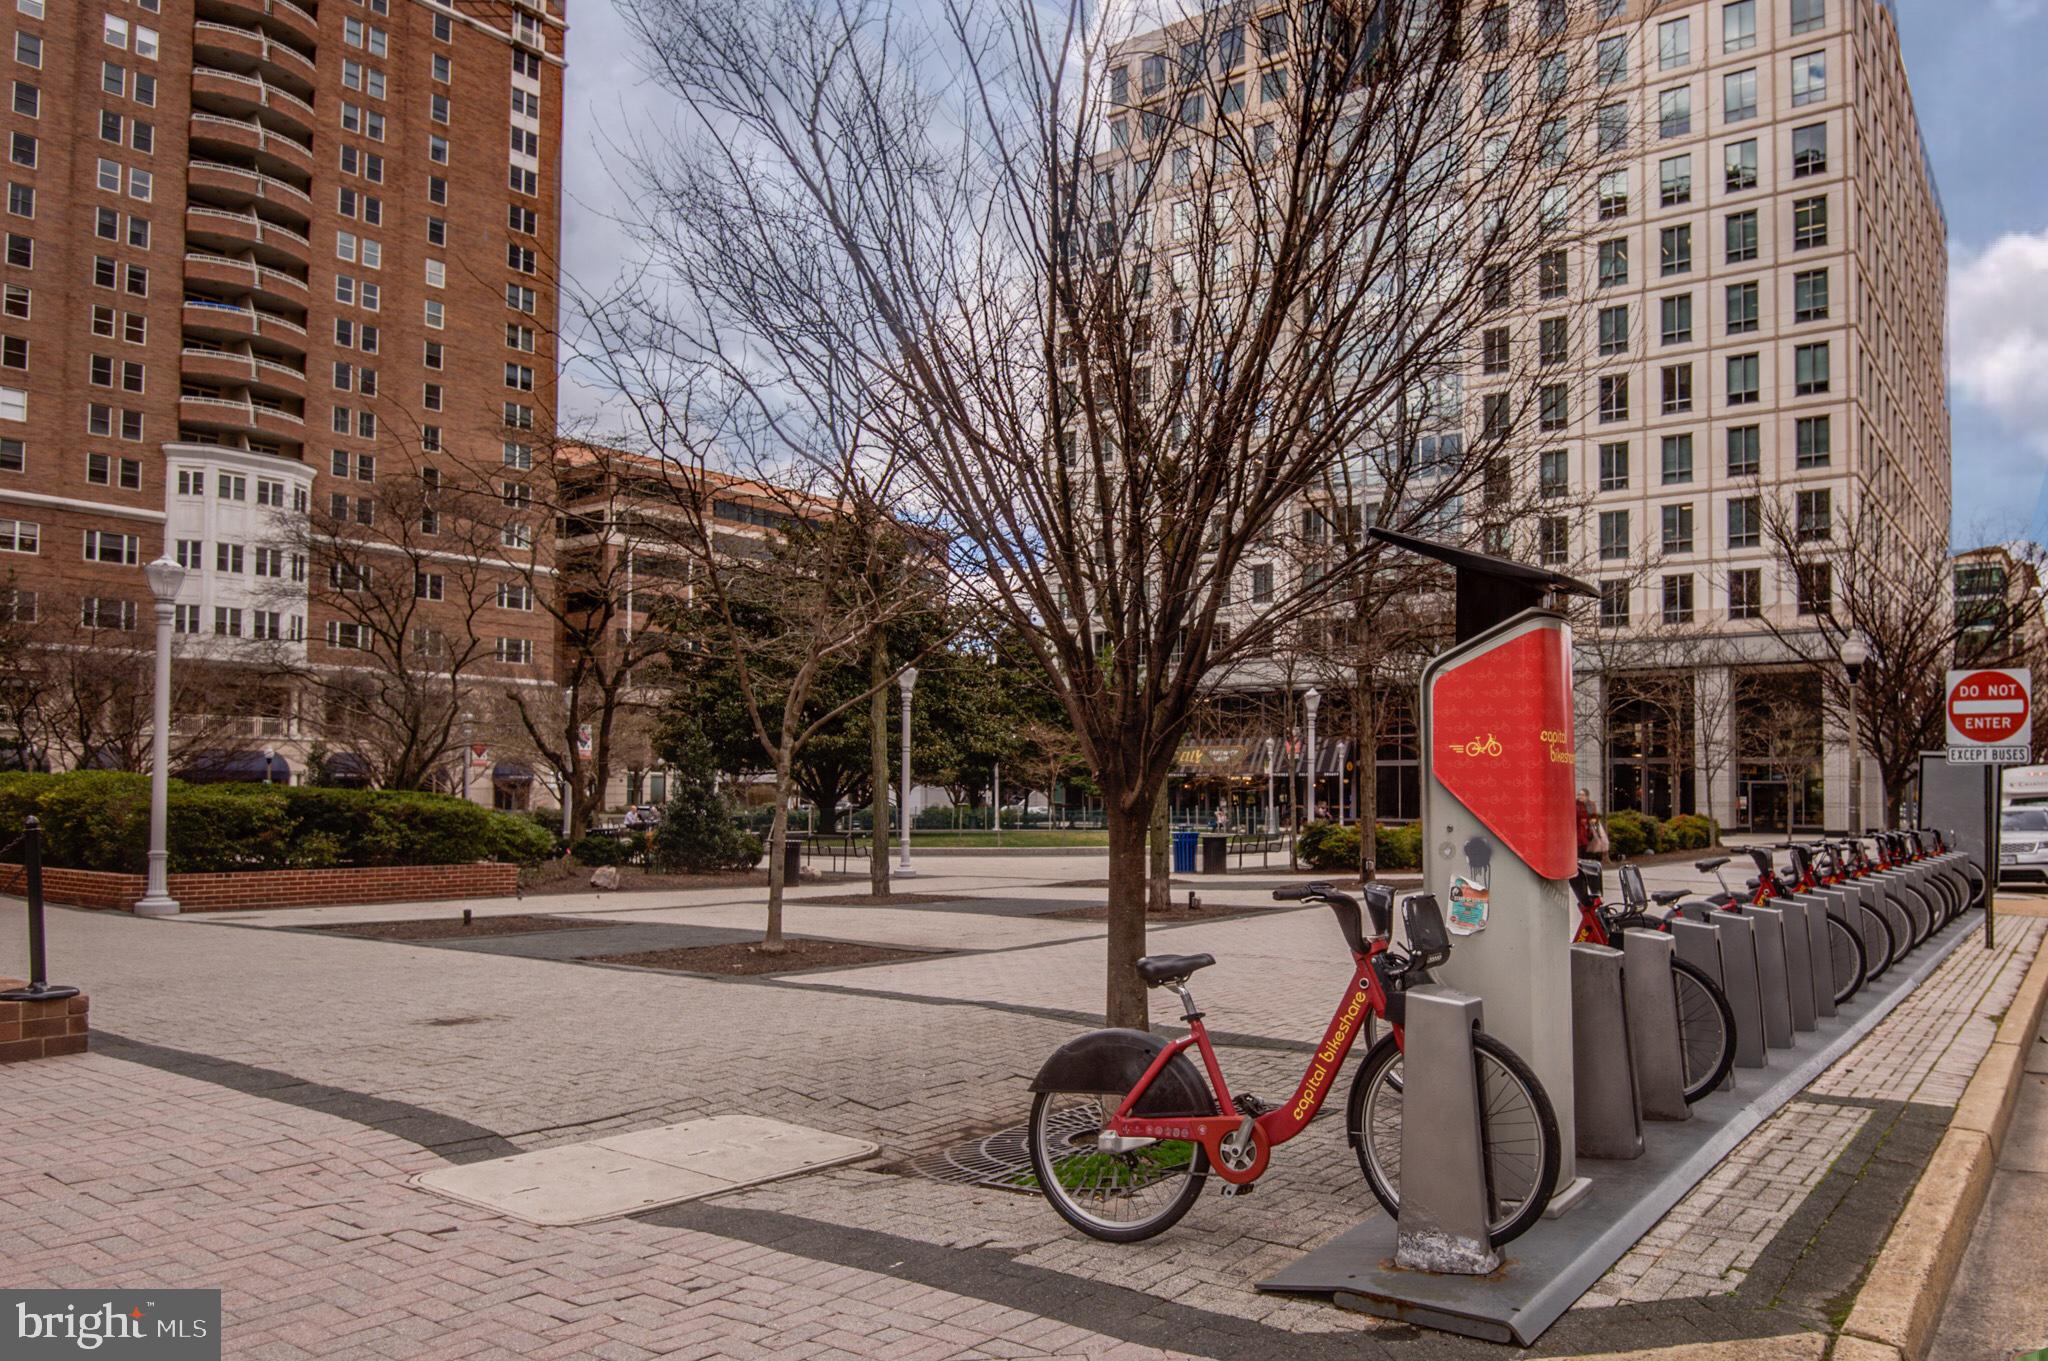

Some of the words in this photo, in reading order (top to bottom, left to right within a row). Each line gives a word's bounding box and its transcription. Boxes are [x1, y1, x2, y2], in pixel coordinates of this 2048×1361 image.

[1960, 685, 1980, 697] DO
[1988, 684, 2017, 697] NOT
[1965, 717, 2012, 729] ENTER
[1540, 730, 1568, 746] capital
[1951, 749, 1988, 761] EXCEPT
[1992, 748, 2026, 761] BUSES
[1293, 1063, 1327, 1121] capital
[1318, 991, 1367, 1063] bikeshare
